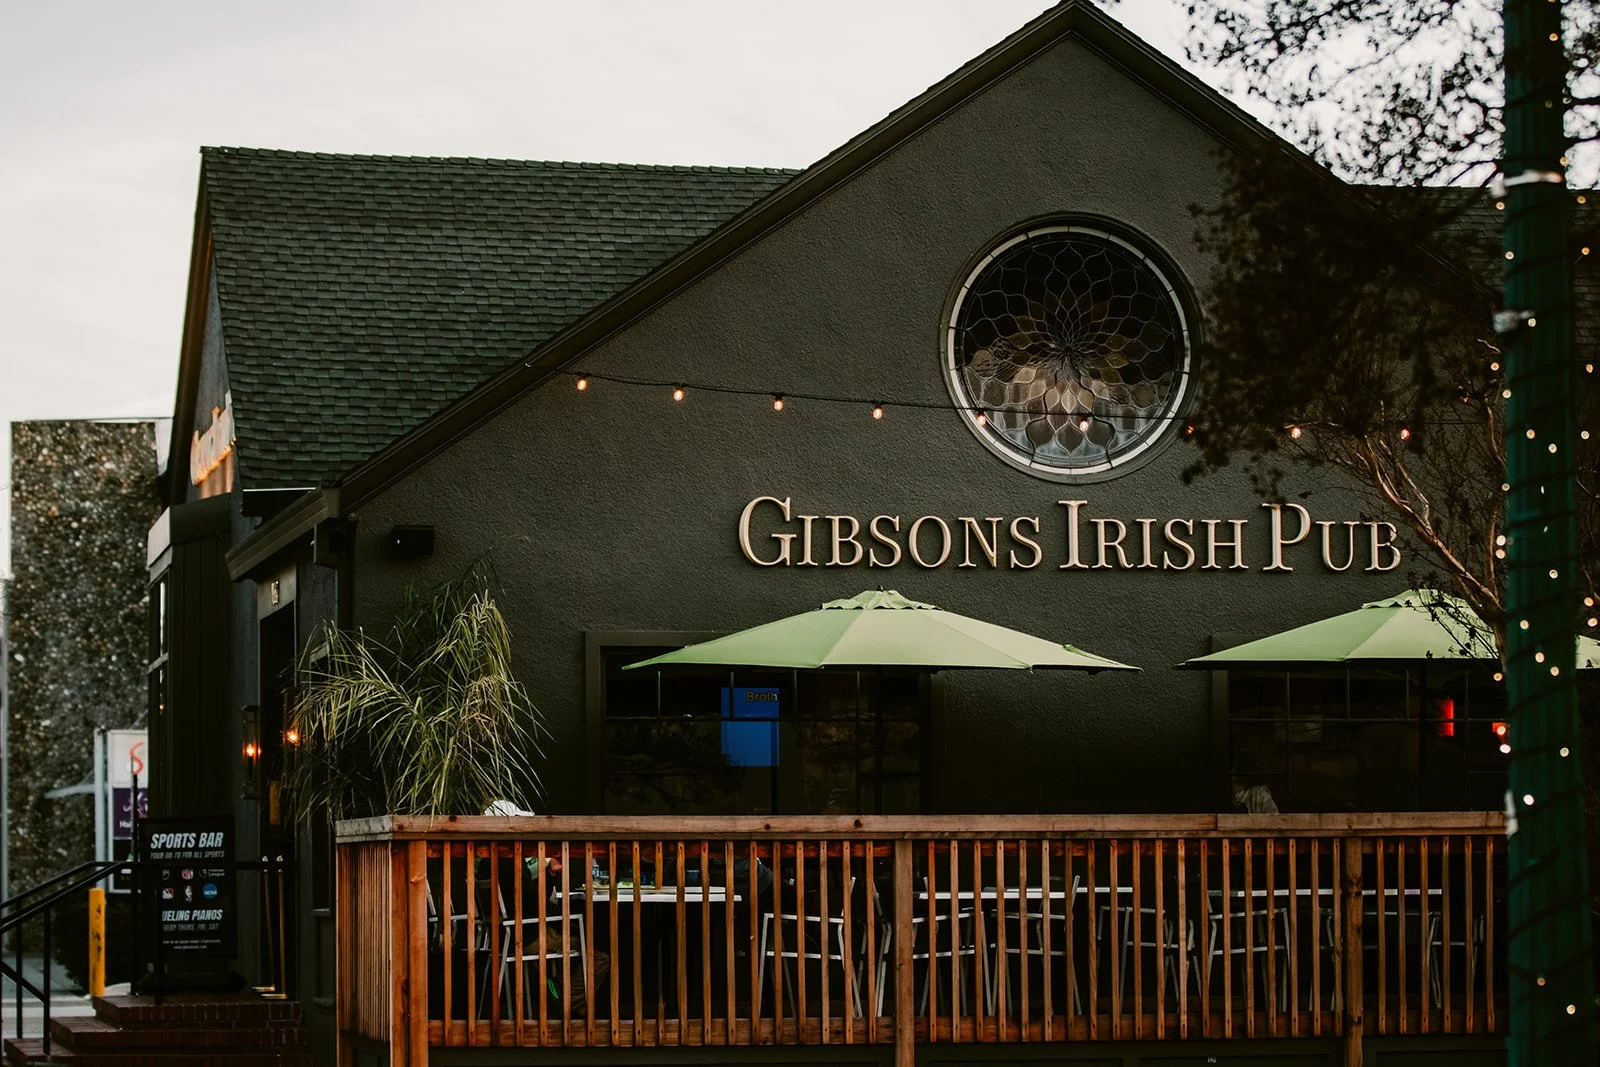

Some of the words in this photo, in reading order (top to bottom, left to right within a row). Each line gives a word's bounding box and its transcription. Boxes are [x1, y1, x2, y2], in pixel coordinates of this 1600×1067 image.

[738, 496, 1042, 568] GIBSONS
[1058, 500, 1250, 570] IRISH
[746, 691, 778, 702] Broth
[150, 832, 197, 849] SPORTS
[198, 832, 224, 848] BAR
[203, 850, 225, 858] SPORTS
[161, 910, 190, 921] UELING
[192, 909, 223, 921] PIANOS
